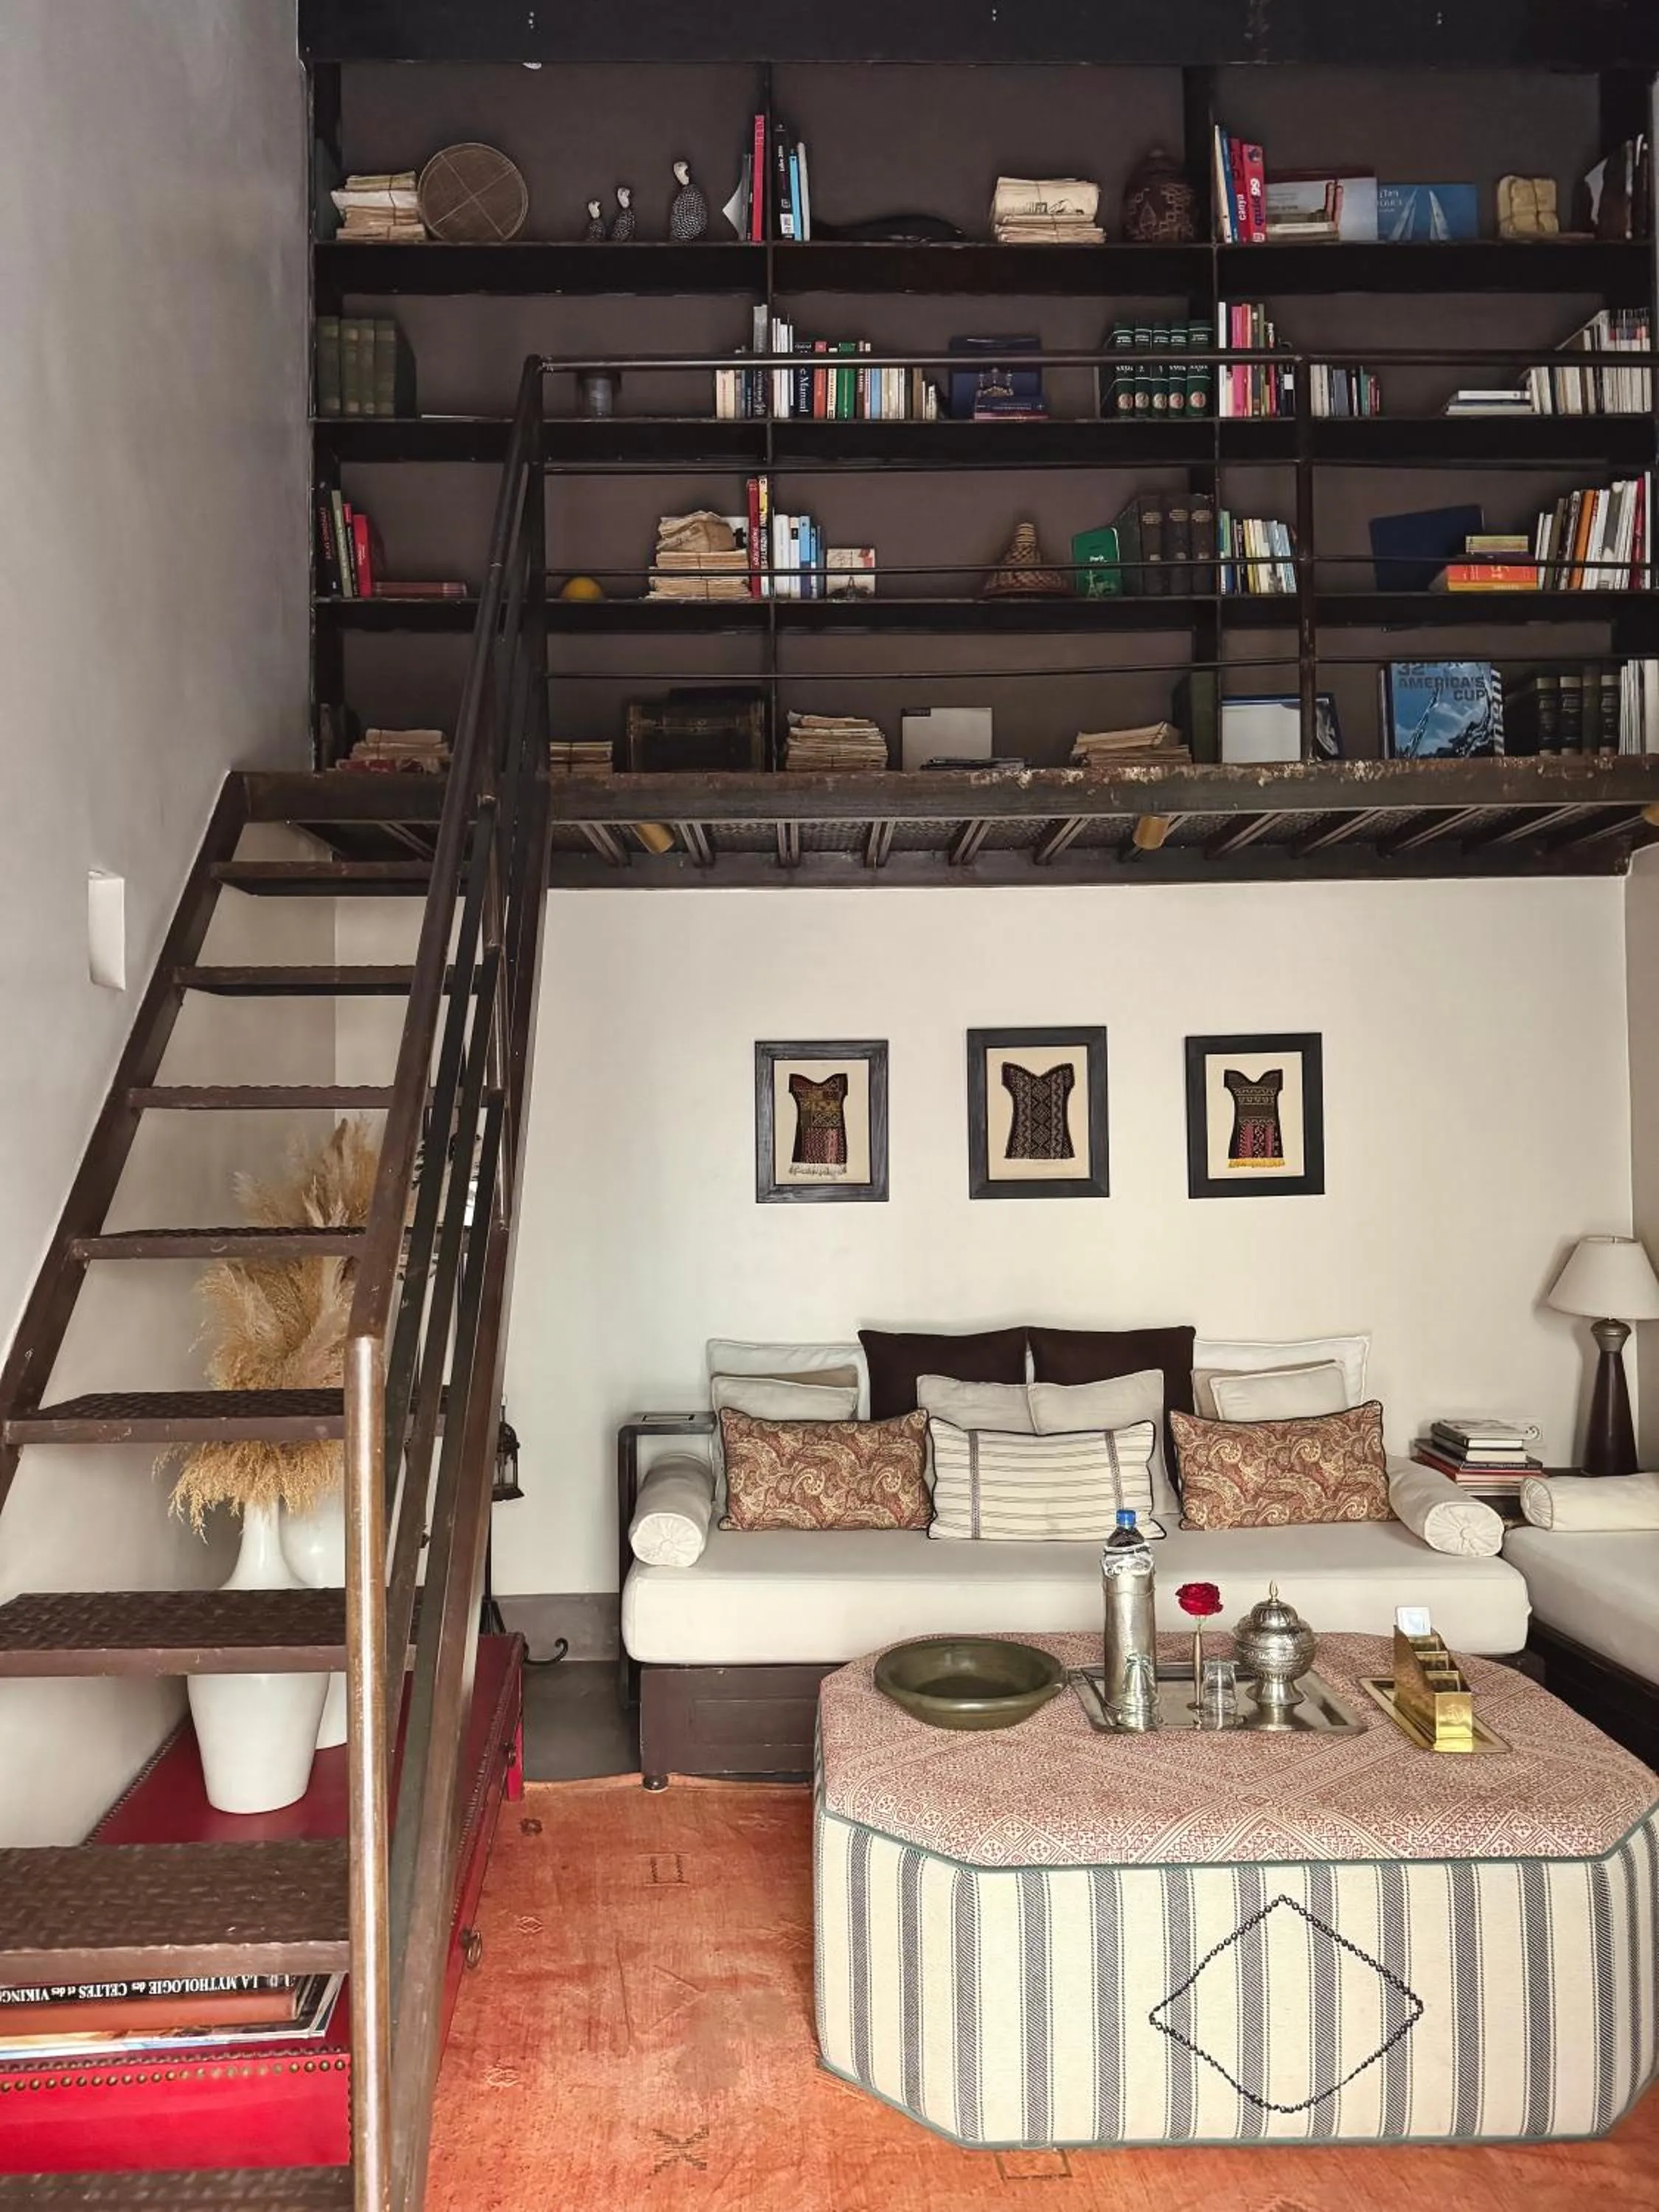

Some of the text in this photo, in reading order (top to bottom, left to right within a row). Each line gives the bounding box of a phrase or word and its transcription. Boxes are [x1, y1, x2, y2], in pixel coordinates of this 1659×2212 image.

[799, 377, 810, 413] Manual
[1399, 677, 1486, 689] AMERICA'S
[1453, 689, 1486, 701] CUP
[131, 1981, 147, 1992] des
[148, 1976, 237, 1994] MYTHOLOGIE
[242, 1975, 258, 1989] LA
[0, 1989, 50, 2003] VIKING
[51, 1987, 66, 1997] des
[79, 1983, 128, 1998] CELTES
